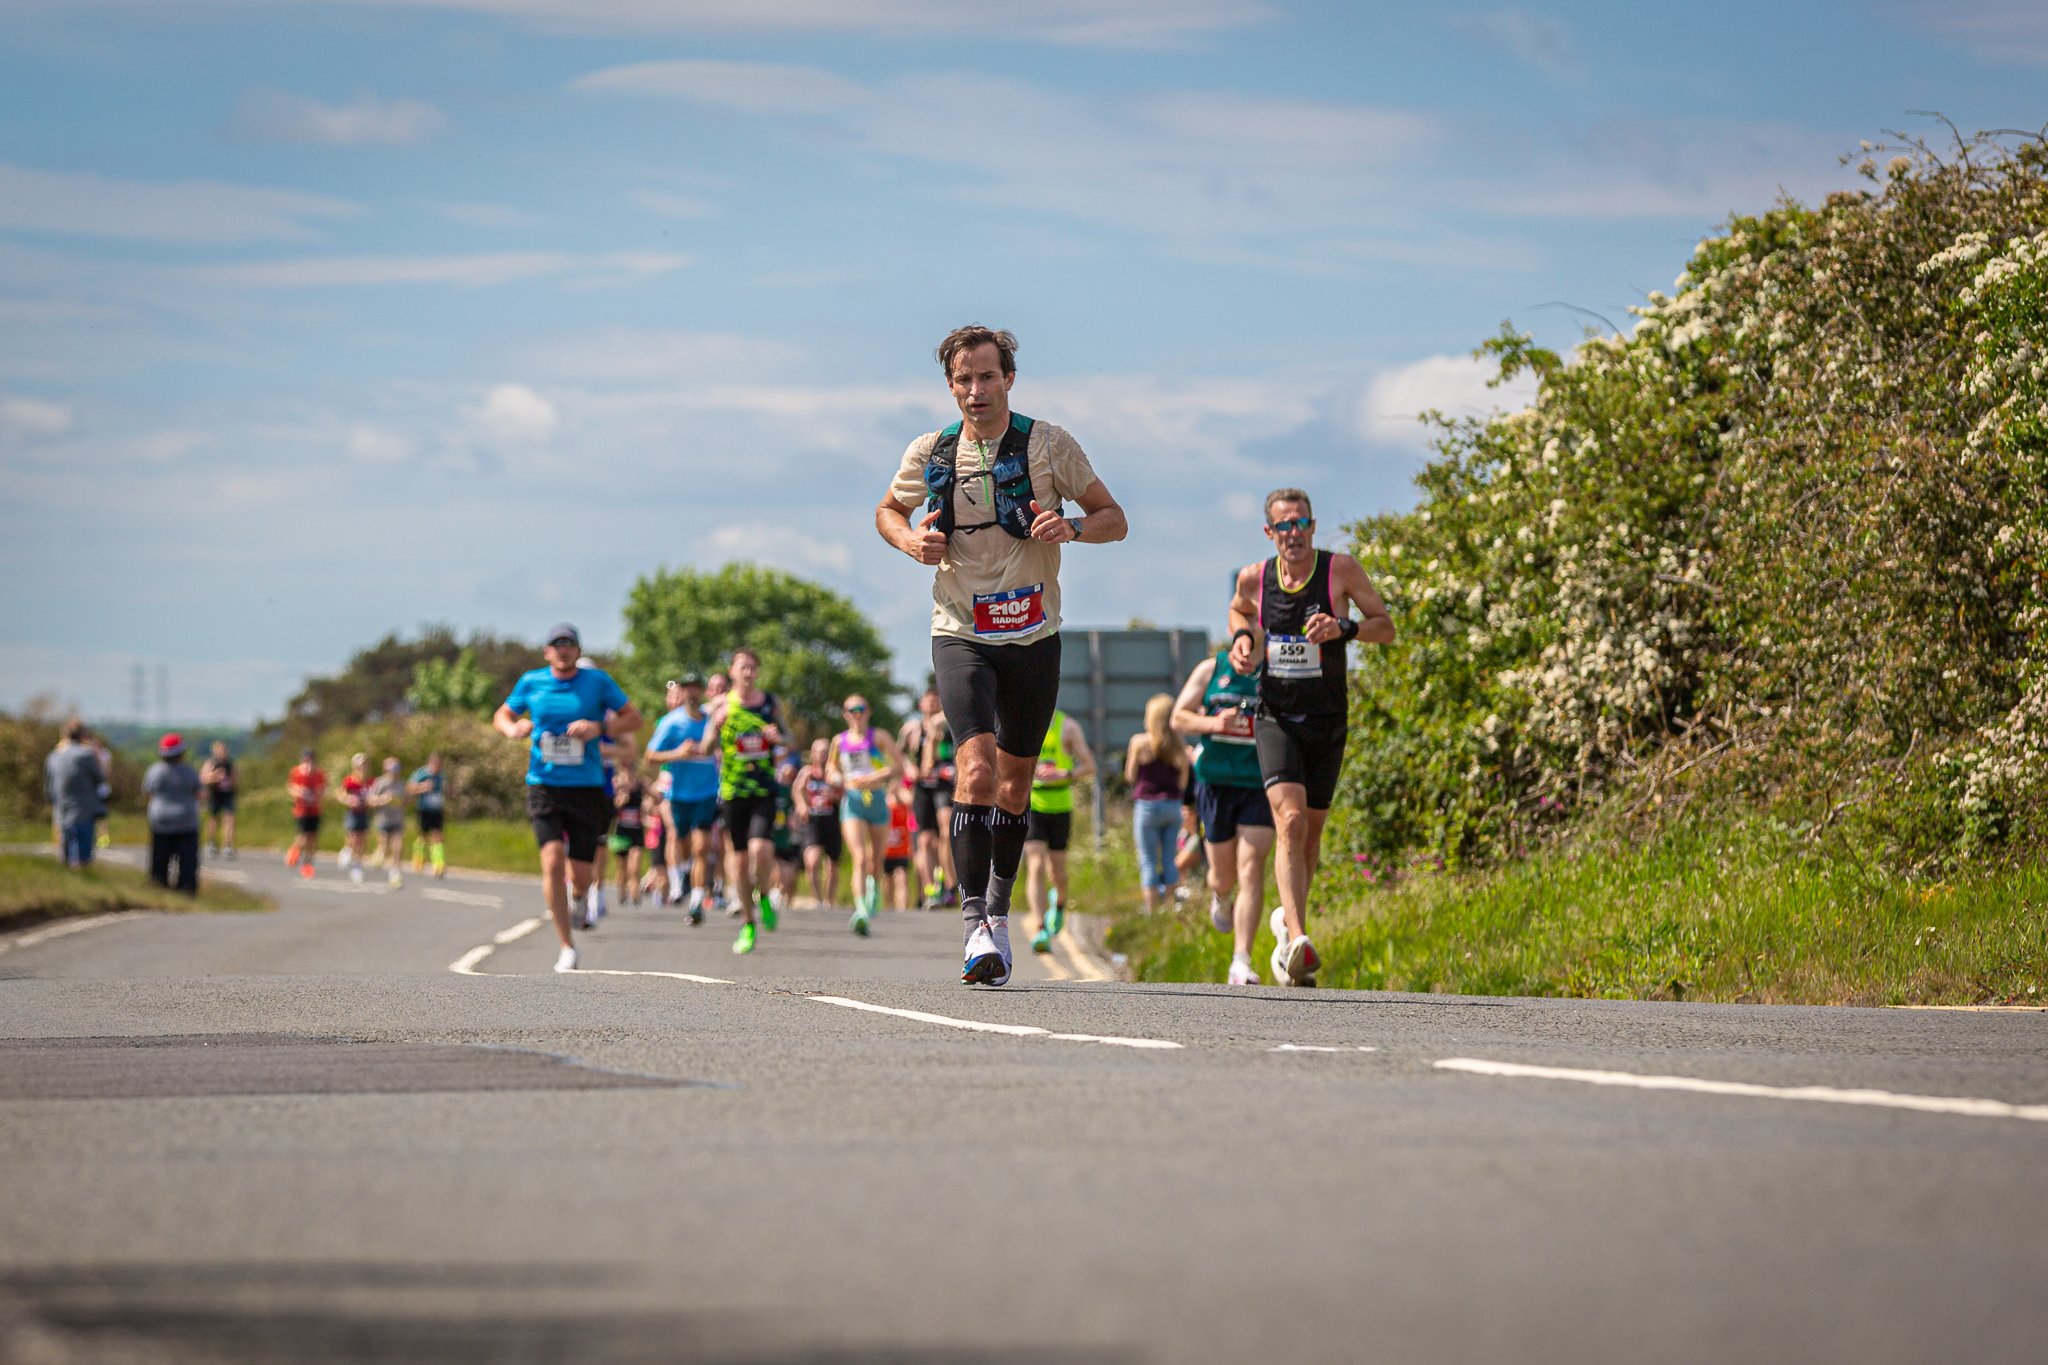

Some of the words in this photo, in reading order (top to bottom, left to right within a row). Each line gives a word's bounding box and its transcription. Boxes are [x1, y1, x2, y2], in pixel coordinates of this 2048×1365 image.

[988, 597, 1030, 615] 2106
[992, 613, 1029, 624] HADRIEN
[1280, 644, 1305, 656] 559
